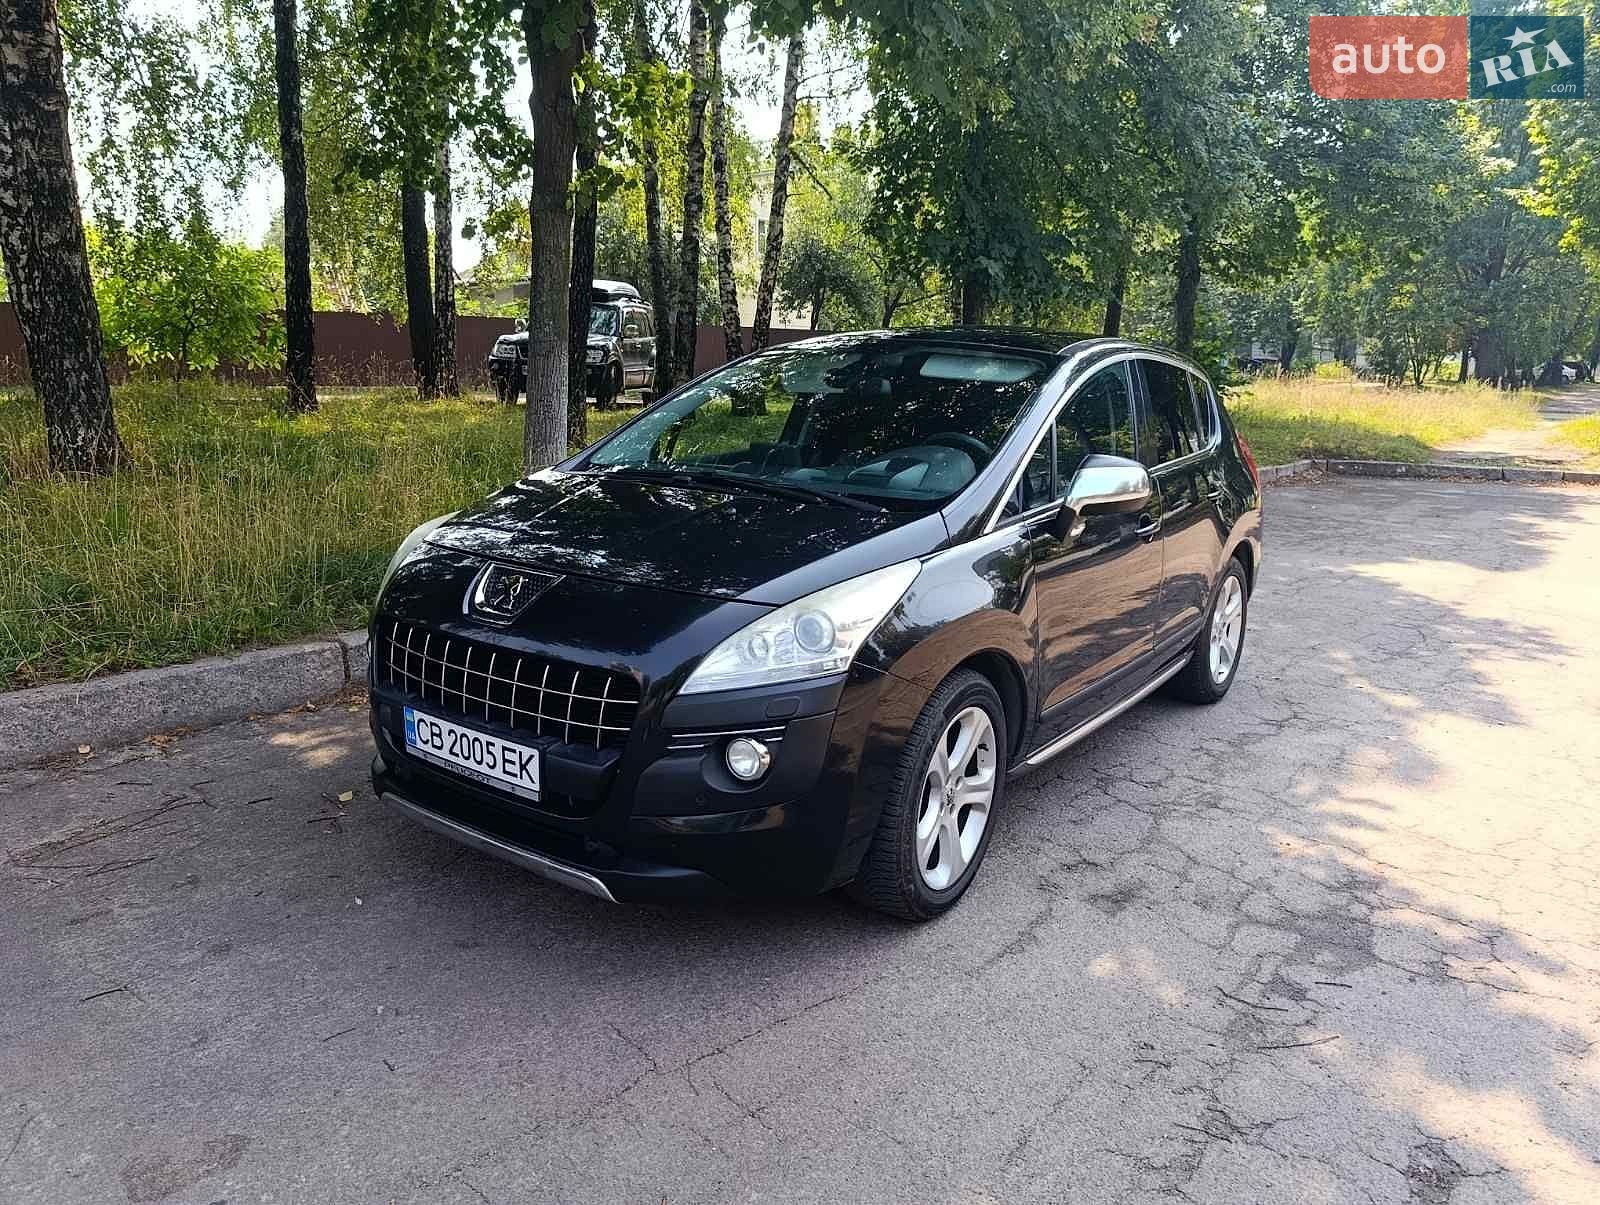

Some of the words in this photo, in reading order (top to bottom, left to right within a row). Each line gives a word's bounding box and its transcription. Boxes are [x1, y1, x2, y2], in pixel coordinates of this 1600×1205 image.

[417, 718, 444, 750] CB
[448, 729, 497, 770] 2005
[501, 744, 536, 784] EK
